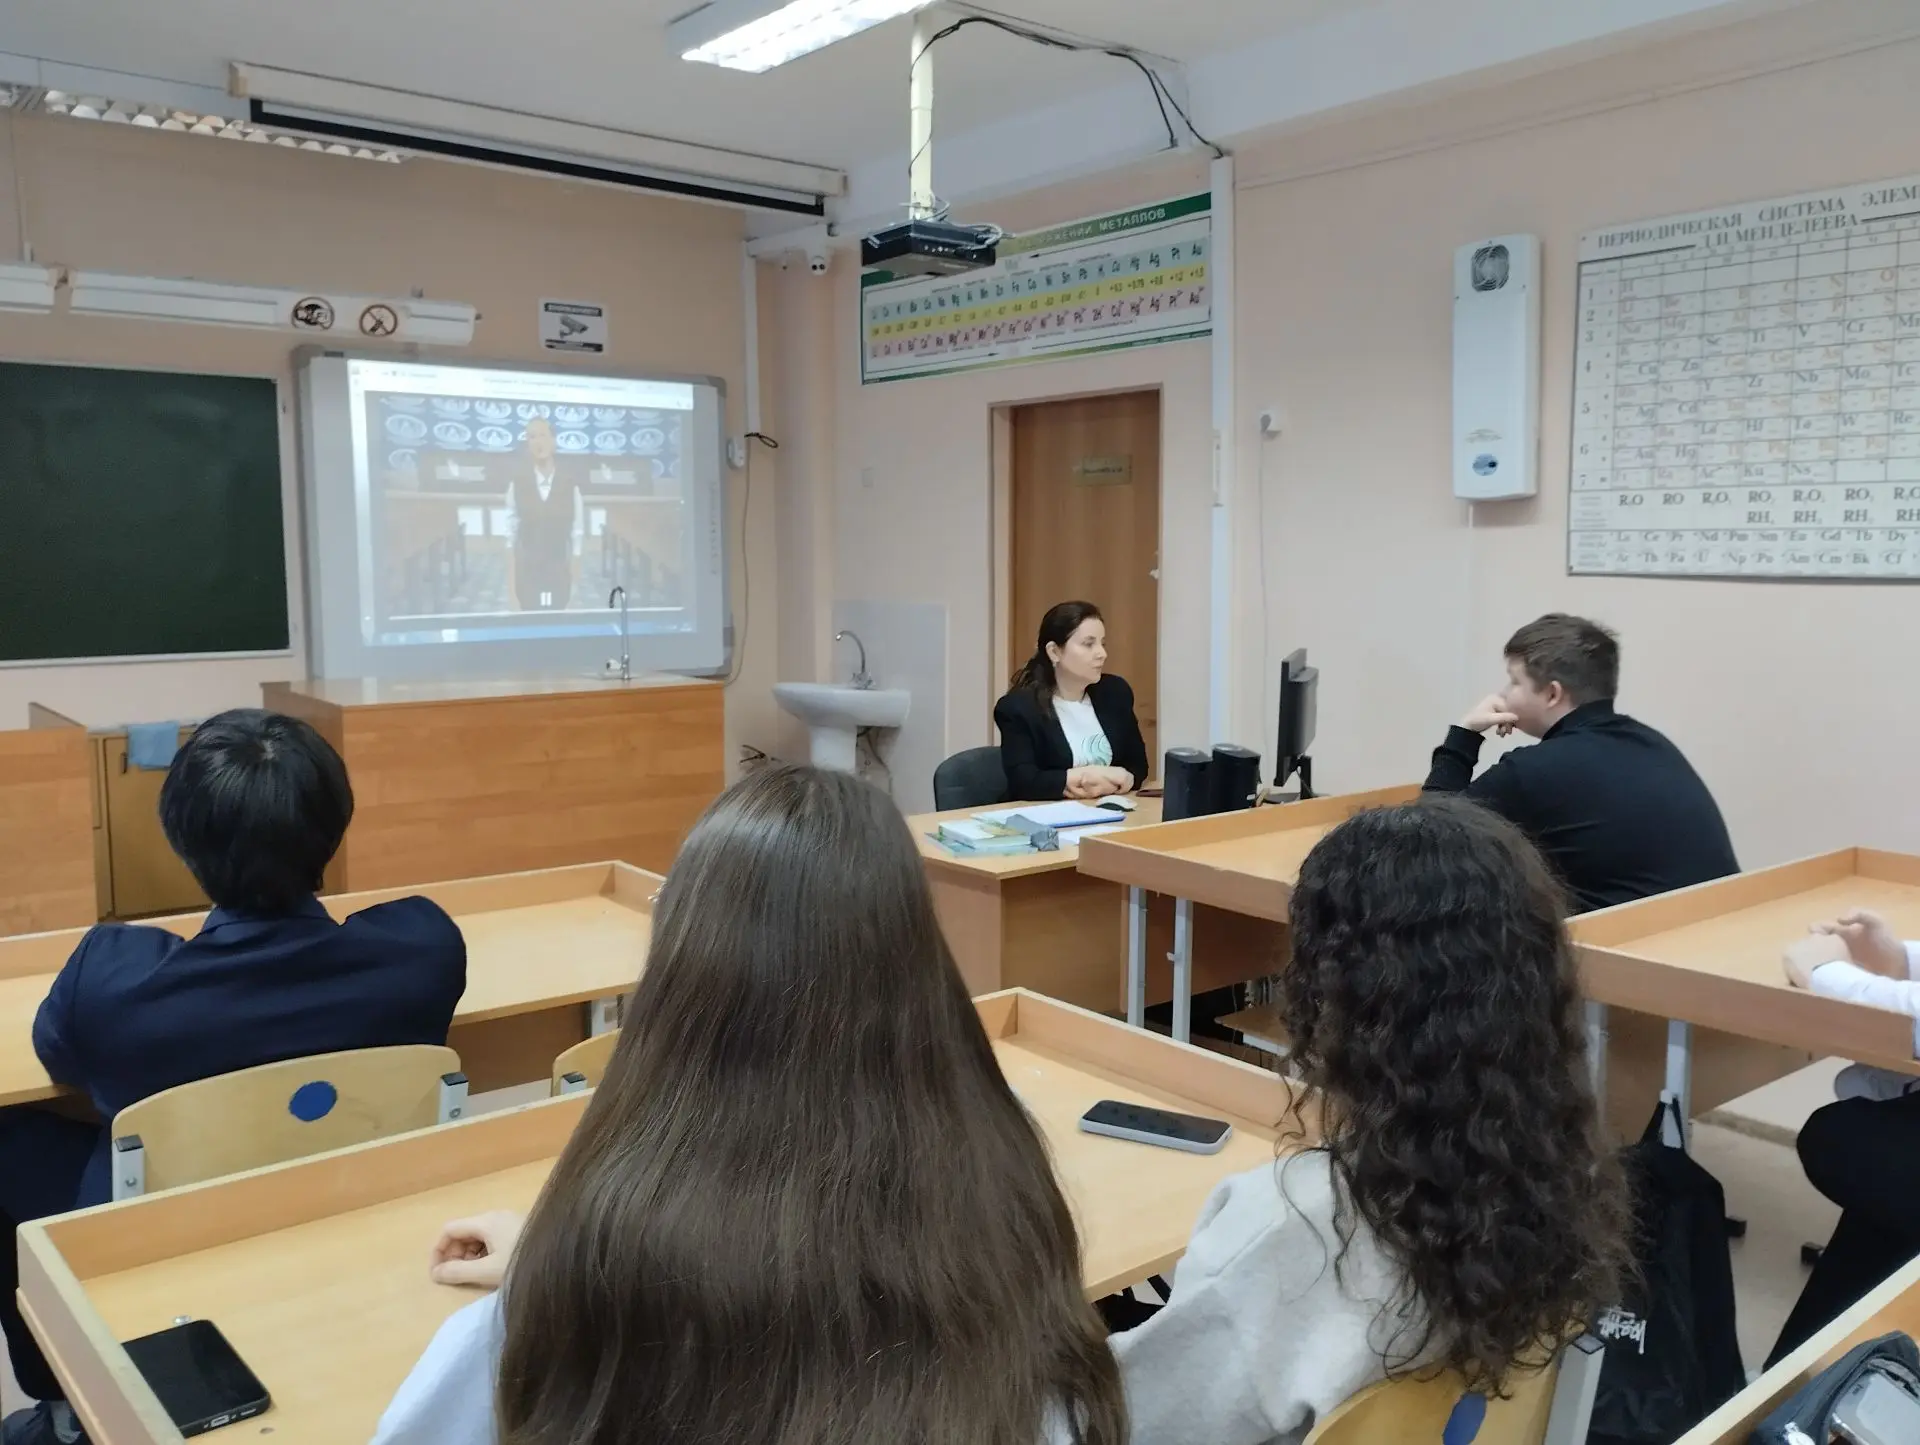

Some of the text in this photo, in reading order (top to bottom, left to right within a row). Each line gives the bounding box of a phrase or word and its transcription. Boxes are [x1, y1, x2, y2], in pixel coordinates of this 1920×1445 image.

[1099, 207, 1166, 232] МЕТАЛЛОВ
[1598, 212, 1742, 249] ПЕРИОДИЧЕСКАЯ
[1758, 195, 1846, 223] СИСТЕМА
[1662, 492, 1684, 506] RO
